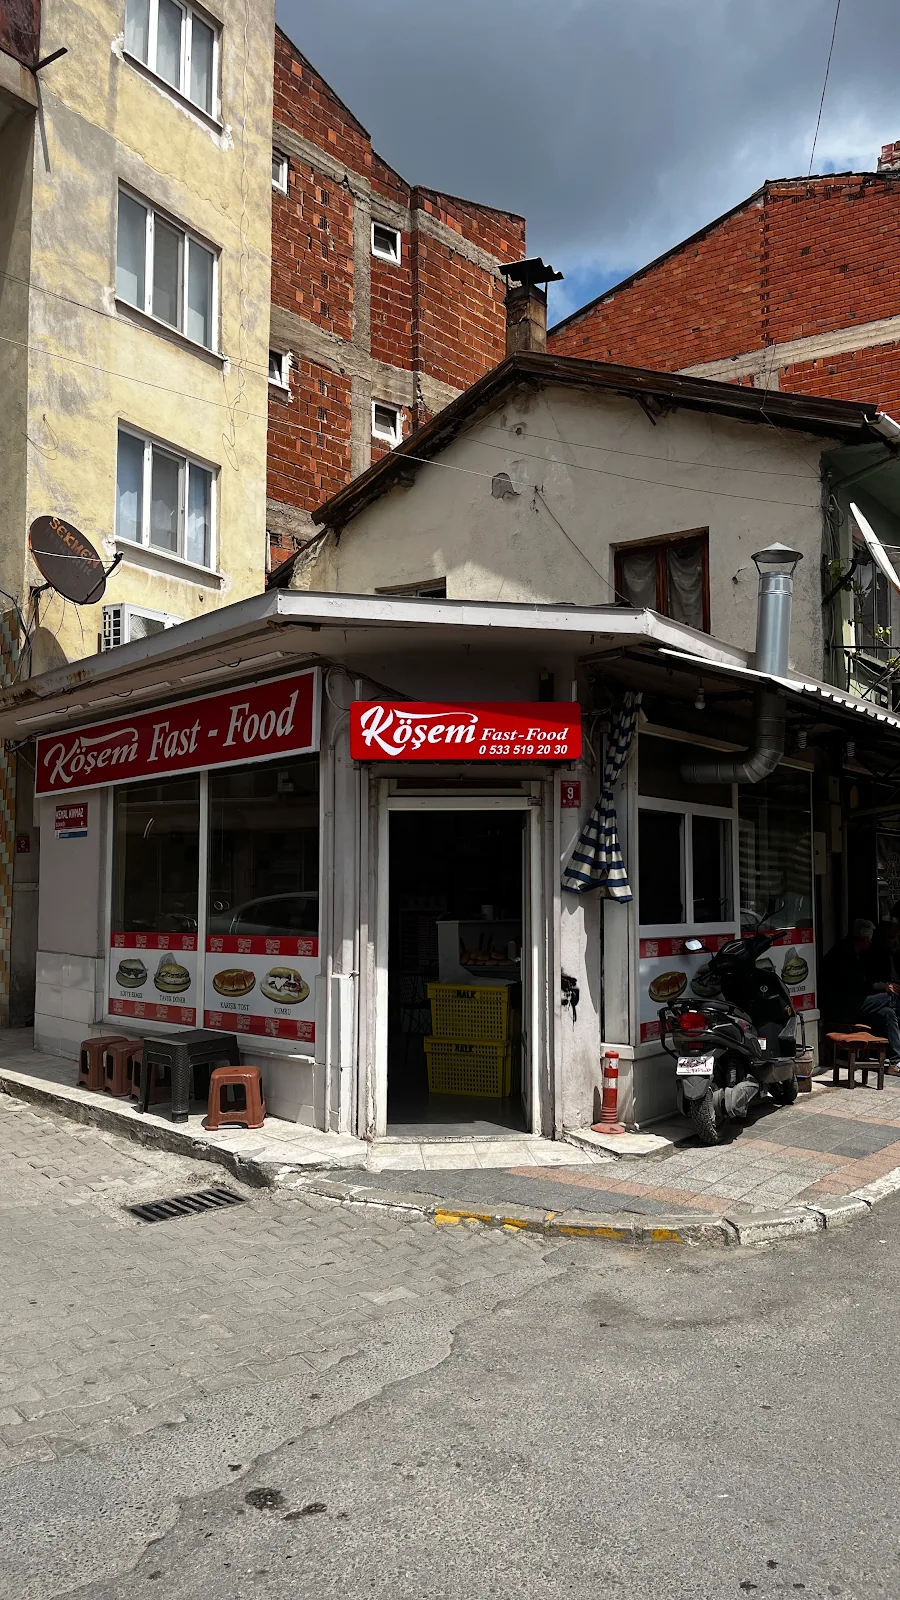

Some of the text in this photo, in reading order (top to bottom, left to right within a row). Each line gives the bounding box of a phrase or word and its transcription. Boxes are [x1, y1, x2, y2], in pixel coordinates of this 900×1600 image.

[49, 517, 100, 569] SEKMEN
[43, 689, 299, 784] Köşem Fast - Food
[360, 705, 569, 756] Köşem Fast-Food
[479, 744, 568, 755] 0 533 519 20 30
[567, 786, 574, 800] 9
[21, 840, 26, 848] 2
[456, 989, 477, 999] HALK
[238, 1003, 250, 1011] TOST
